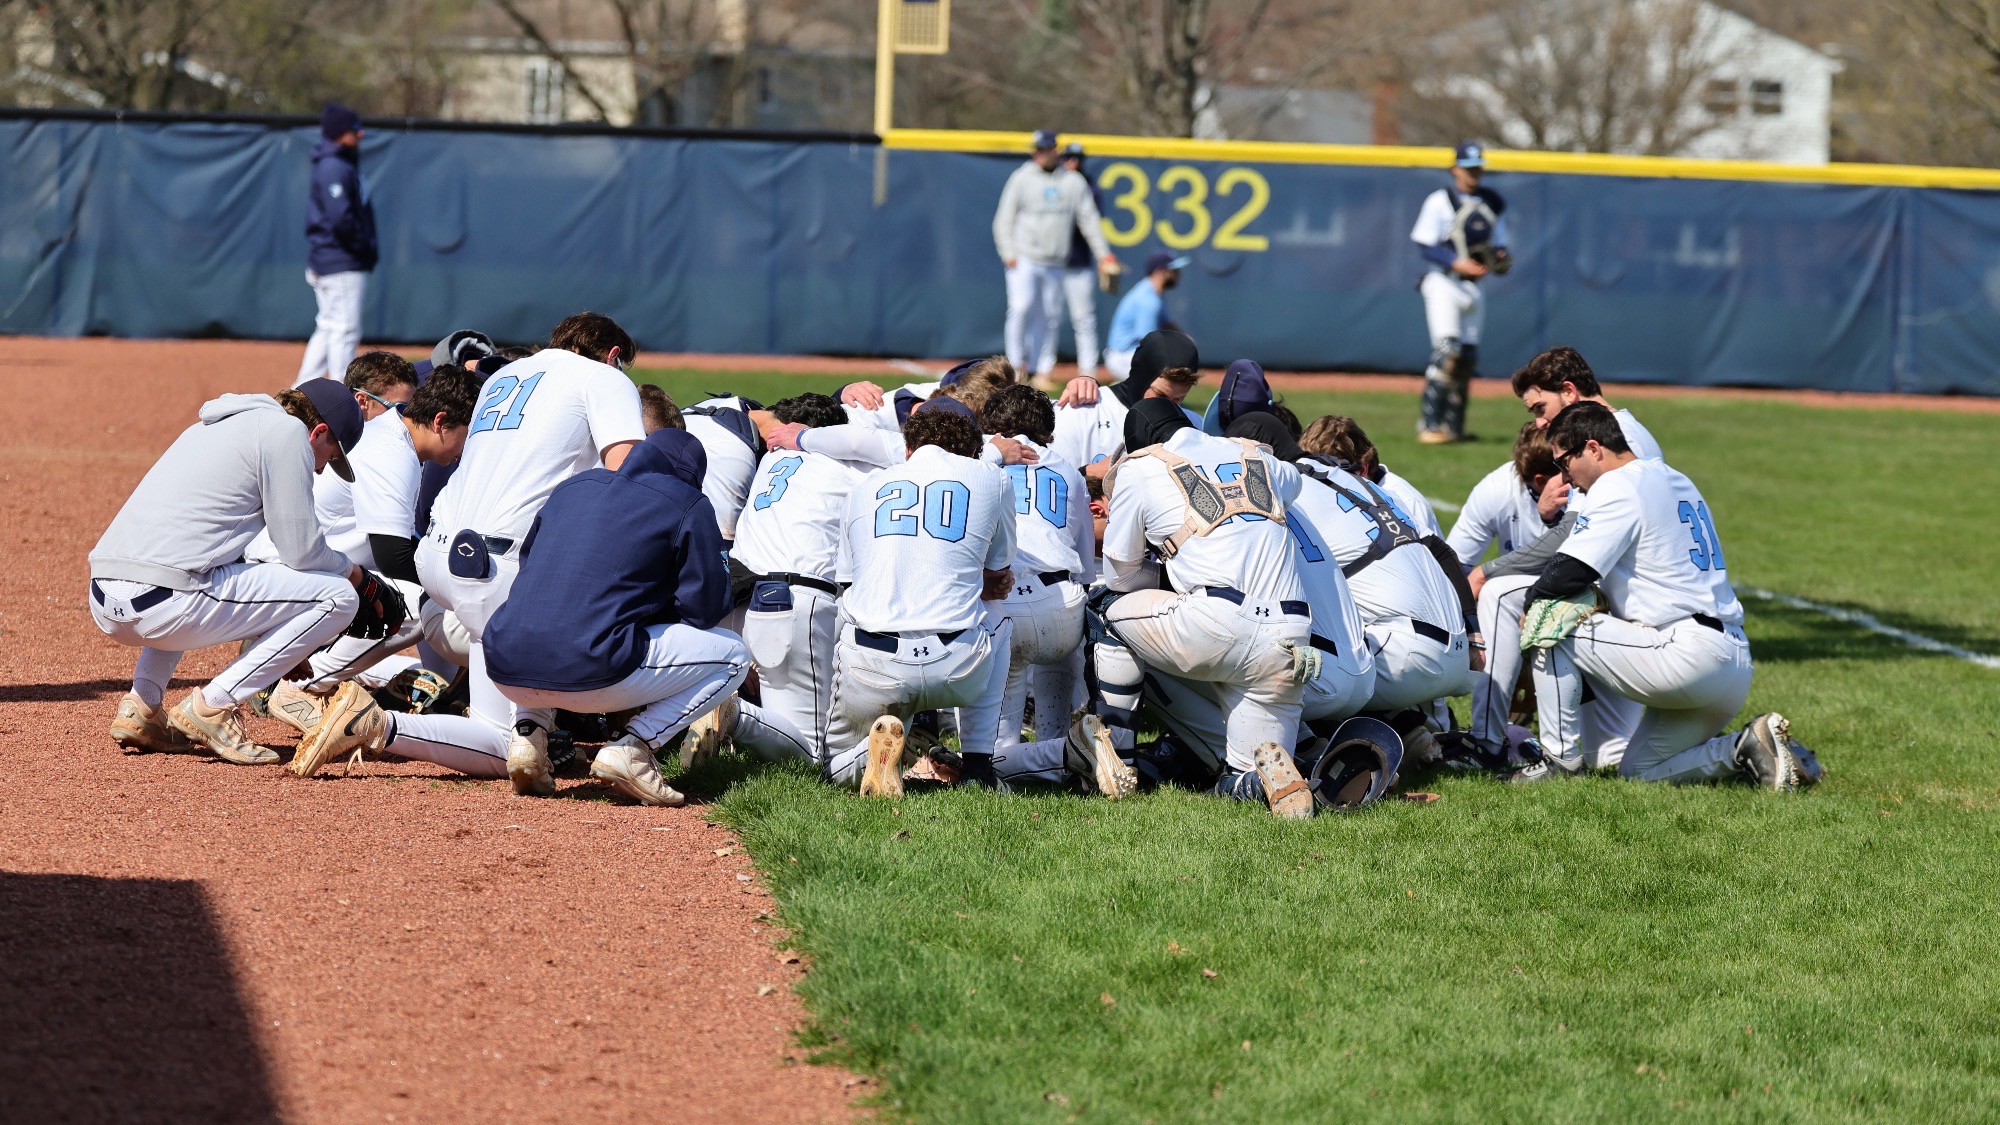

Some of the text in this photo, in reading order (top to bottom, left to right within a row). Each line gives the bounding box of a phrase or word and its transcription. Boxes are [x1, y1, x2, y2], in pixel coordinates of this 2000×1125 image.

[1097, 161, 1271, 251] 332
[469, 371, 546, 438] 21
[753, 455, 804, 512] 3
[874, 479, 971, 543] 20
[1677, 500, 1726, 571] 31
